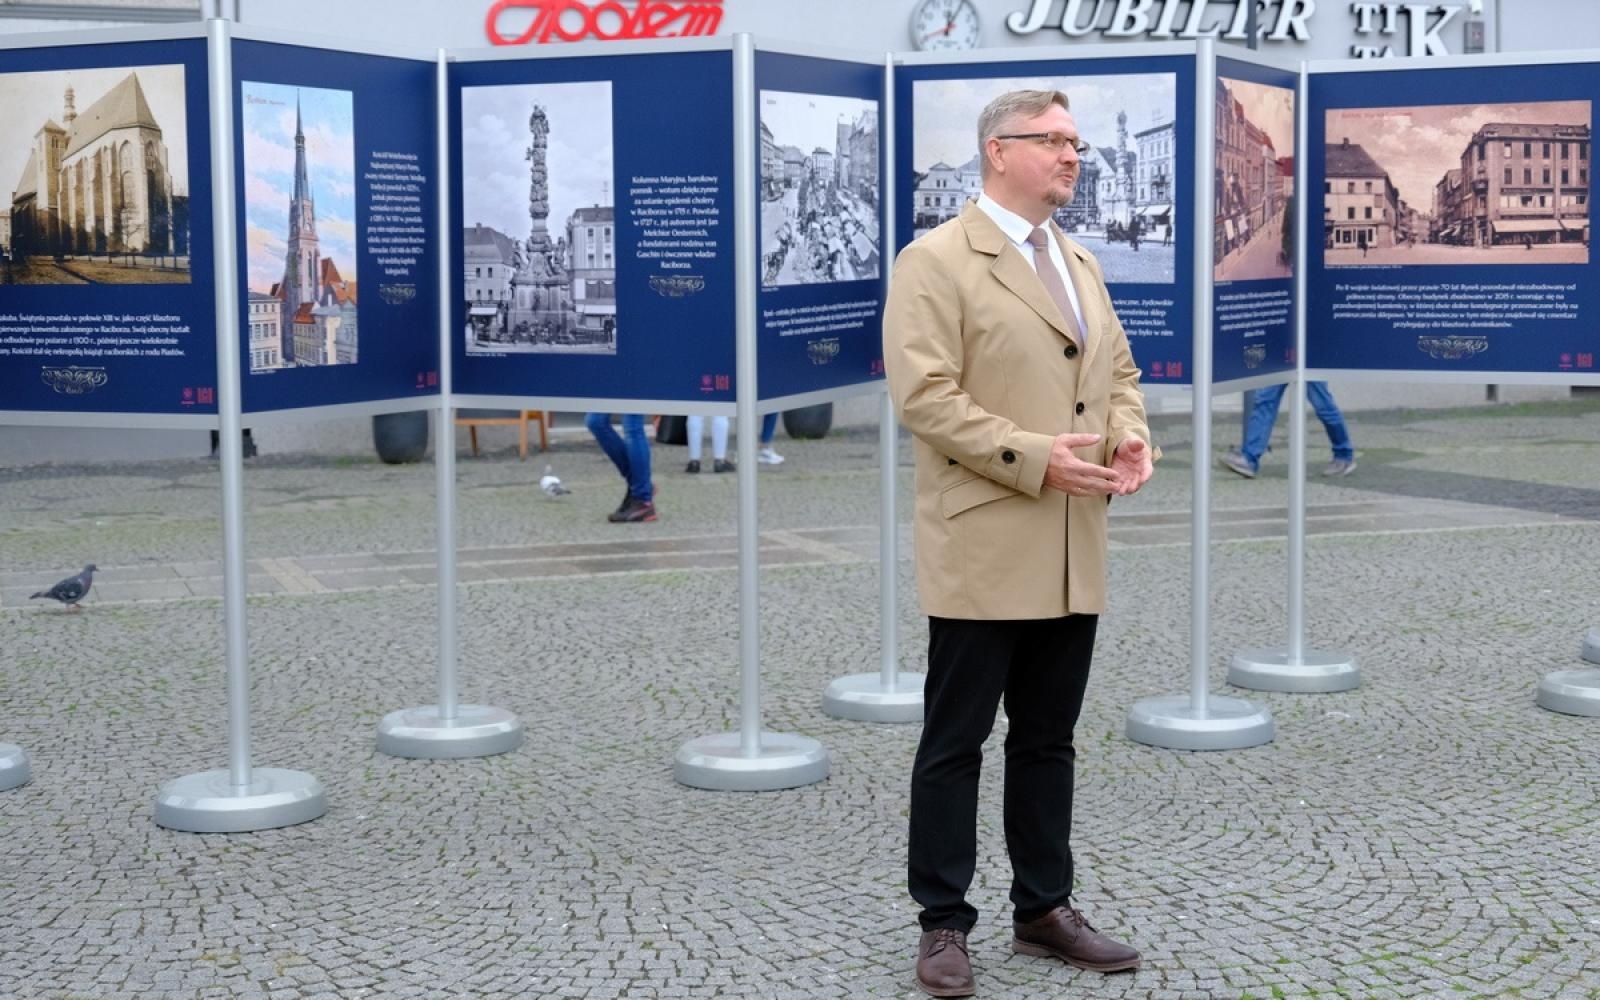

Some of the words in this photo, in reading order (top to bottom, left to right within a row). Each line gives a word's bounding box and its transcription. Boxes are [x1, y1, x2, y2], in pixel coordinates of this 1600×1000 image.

[1007, 0, 1316, 40] JUBILER
[688, 174, 718, 184] barokowy
[630, 186, 652, 196] pomnik
[692, 196, 715, 206] cholery
[637, 208, 667, 216] Raciborzu
[696, 218, 707, 228] jest
[642, 240, 680, 248] fundatorami
[680, 240, 704, 248] rodzina
[694, 250, 716, 258] władze
